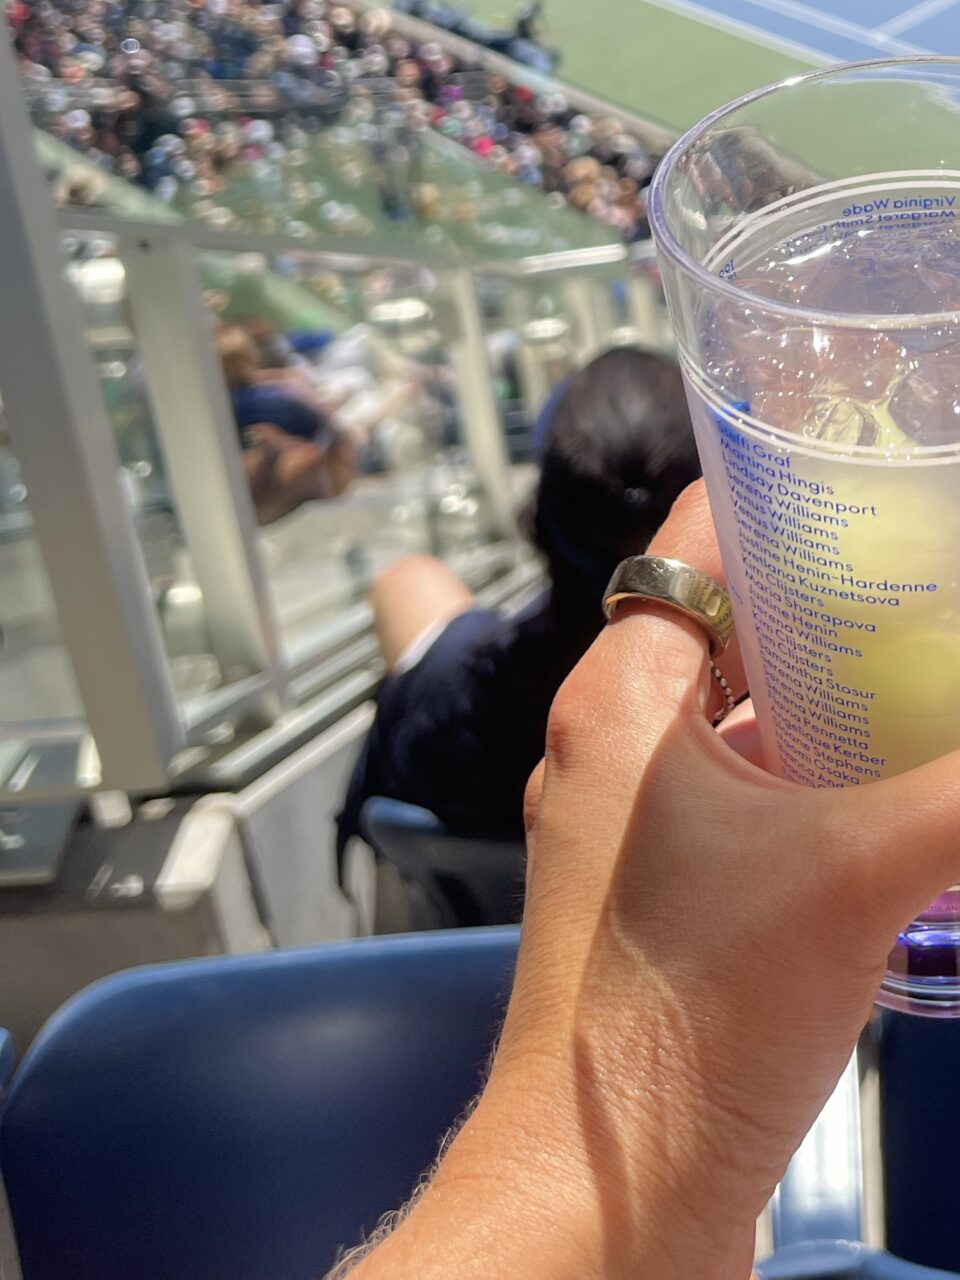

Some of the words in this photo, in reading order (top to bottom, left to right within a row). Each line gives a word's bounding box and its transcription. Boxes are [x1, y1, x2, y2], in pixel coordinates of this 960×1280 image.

[720, 437, 776, 478] Martina
[779, 469, 835, 495] Hingis
[752, 443, 791, 468] Graf
[722, 449, 774, 492] Lindsay
[777, 483, 878, 517] Davenport
[768, 506, 839, 541] Williams
[775, 495, 849, 528] Williams
[770, 521, 841, 556] Williams
[782, 540, 854, 573] Williams
[766, 572, 825, 608] Clijsters
[783, 554, 937, 593] Henin-Hardenne
[798, 575, 900, 607] Kuznetsova
[784, 595, 877, 632] Sharapova
[792, 612, 838, 639] Henin
[775, 628, 832, 663] Clijsters
[795, 626, 863, 658] Williams
[777, 642, 834, 677] Clijsters
[804, 681, 869, 712] Williams
[826, 678, 877, 700] Stosur
[806, 694, 870, 725] Williams
[808, 707, 871, 738] Williams
[803, 717, 869, 751] Pennetta
[813, 746, 881, 778] Stephens
[833, 742, 887, 767] Kerber
[814, 758, 861, 785] Osaka
